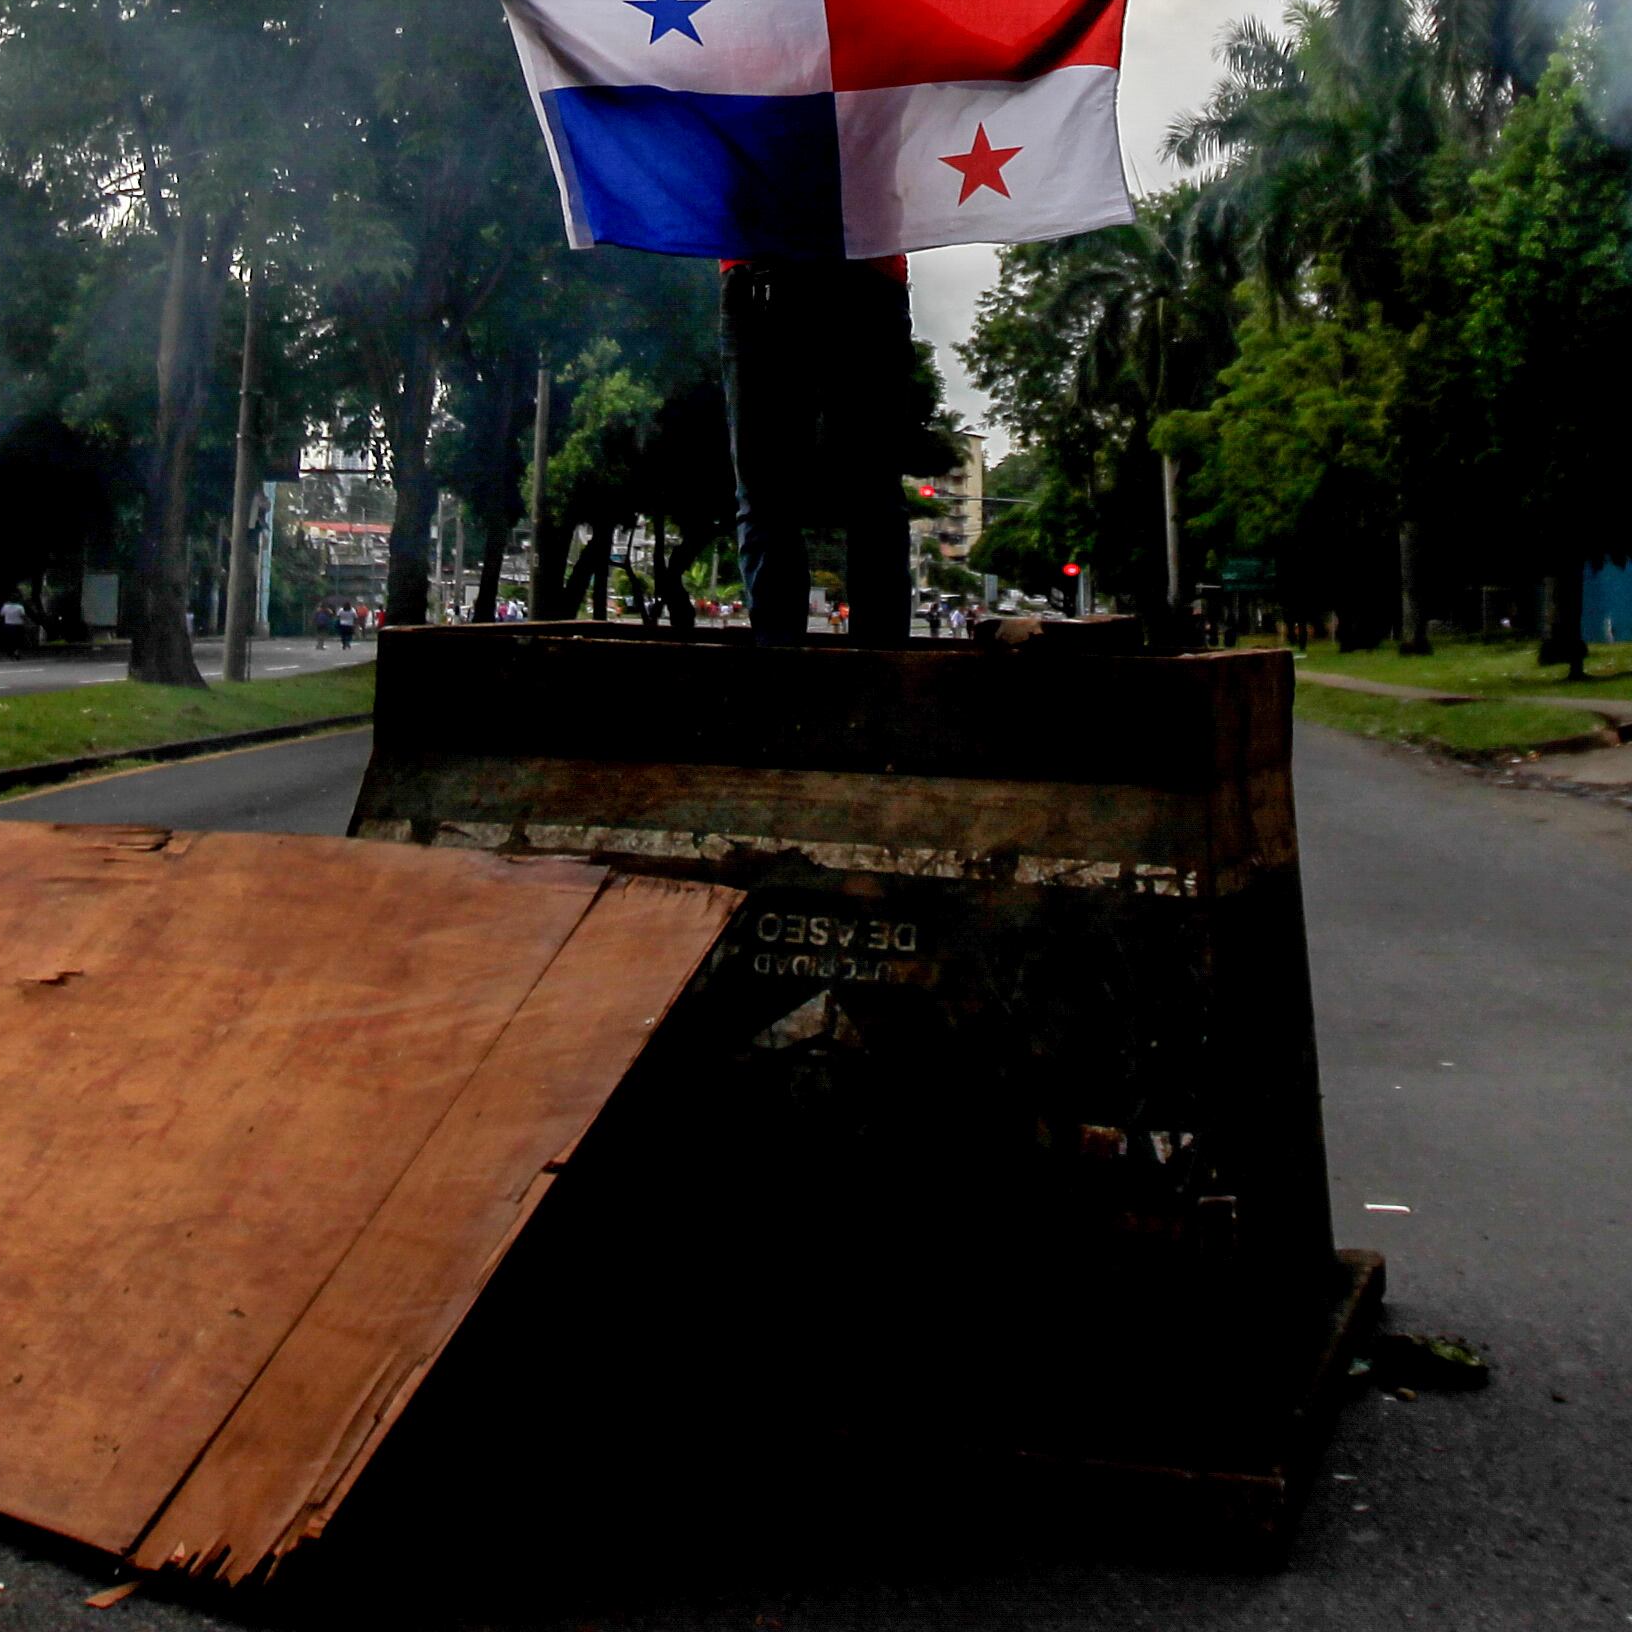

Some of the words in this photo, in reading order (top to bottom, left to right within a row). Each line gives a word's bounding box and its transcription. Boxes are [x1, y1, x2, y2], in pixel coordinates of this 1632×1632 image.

[757, 912, 859, 947] ASEO
[868, 919, 917, 951] DE
[754, 952, 910, 984] UTORIDAD
